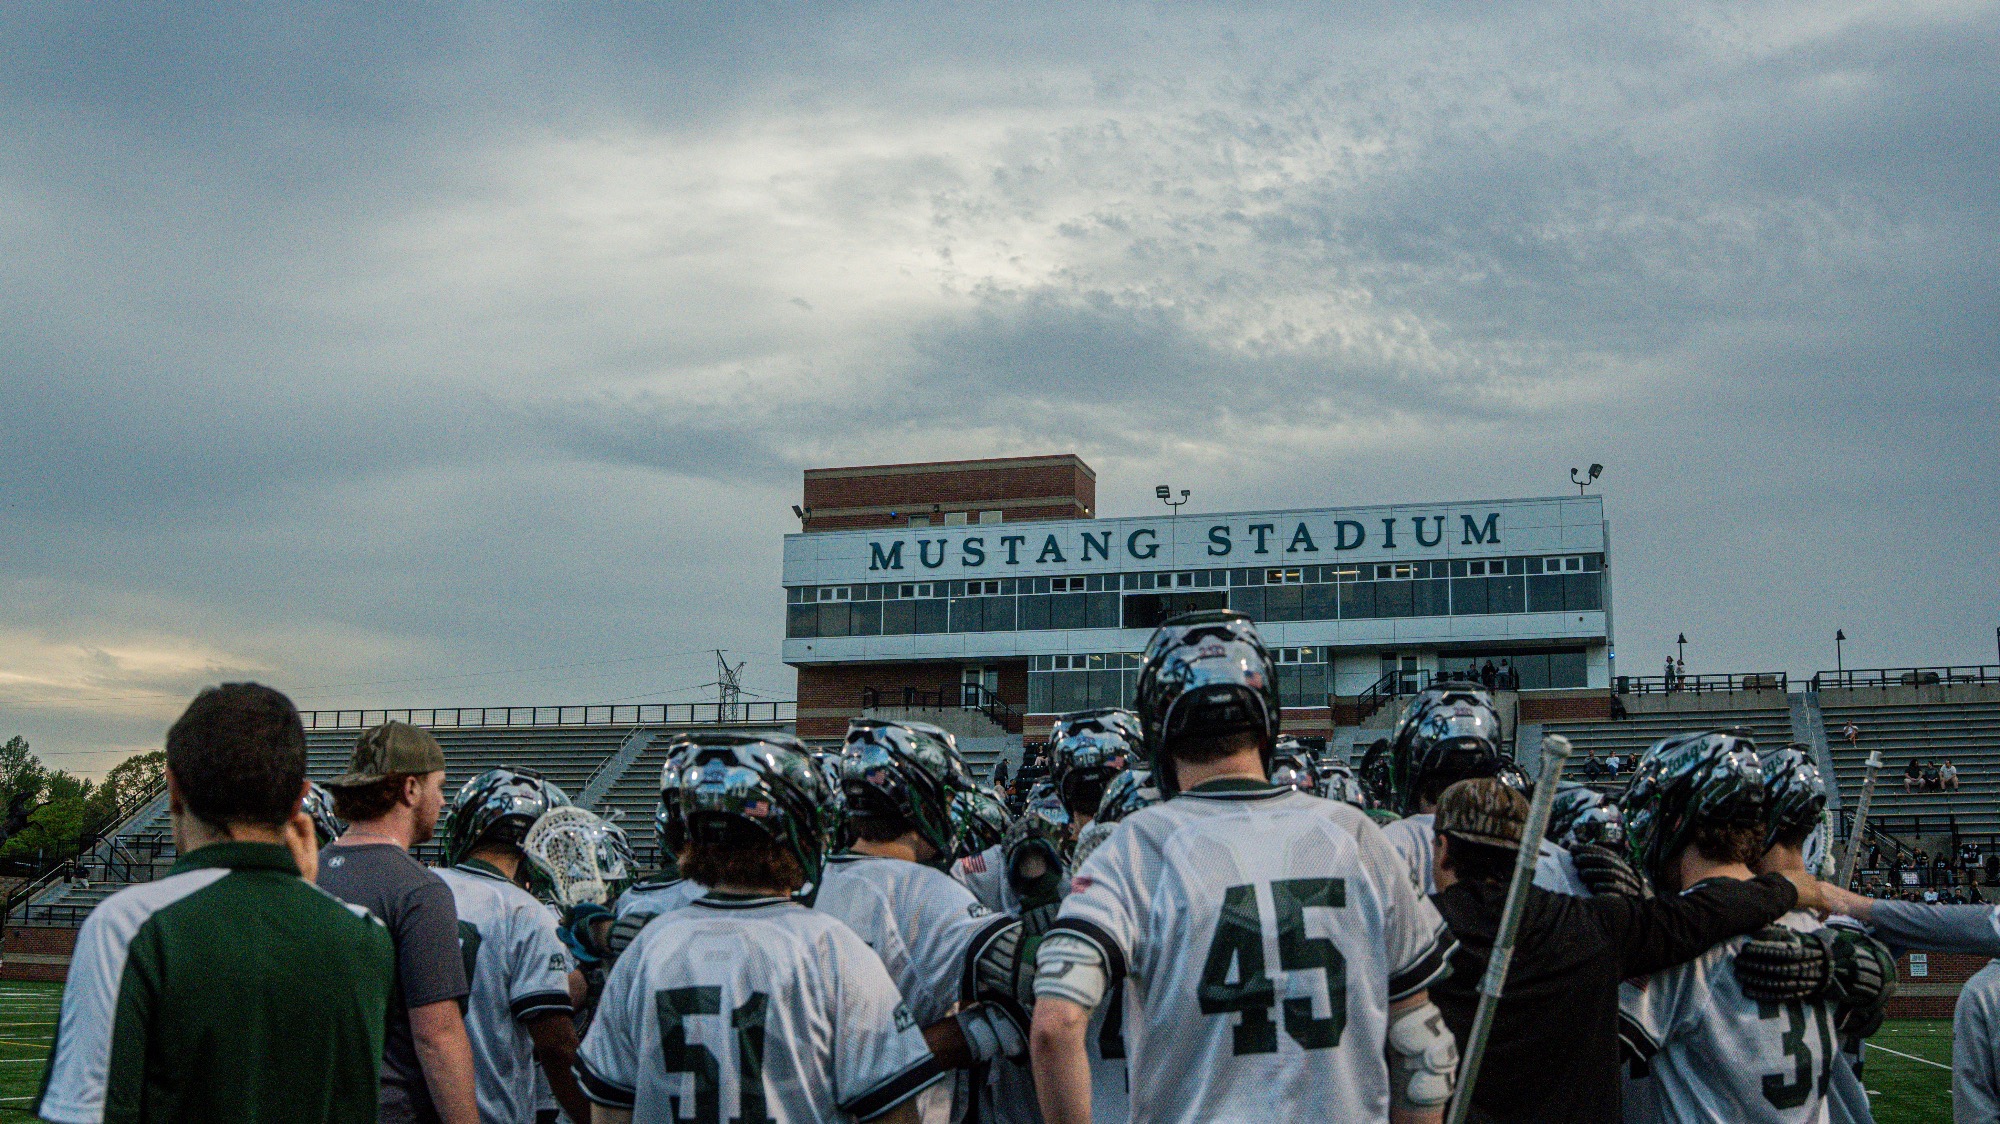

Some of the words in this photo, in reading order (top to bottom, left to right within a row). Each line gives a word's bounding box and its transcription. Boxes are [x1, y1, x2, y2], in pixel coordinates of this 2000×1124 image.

[868, 528, 1160, 571] MUSTANG
[1206, 512, 1501, 556] STADIUM
[1197, 877, 1347, 1056] 45
[655, 985, 777, 1124] 51
